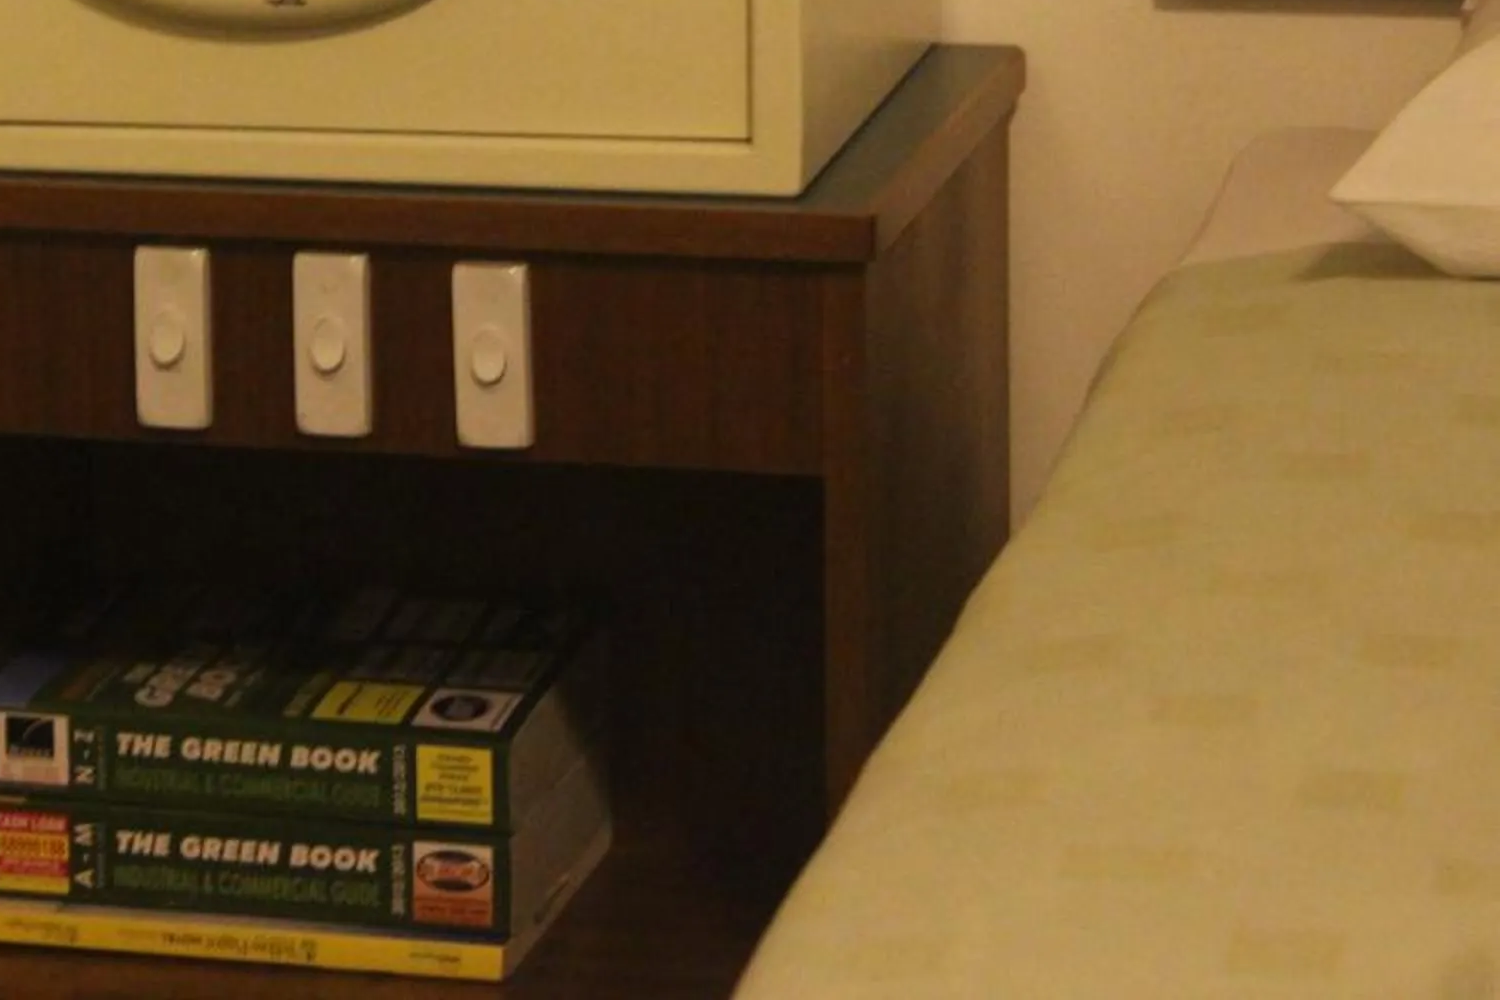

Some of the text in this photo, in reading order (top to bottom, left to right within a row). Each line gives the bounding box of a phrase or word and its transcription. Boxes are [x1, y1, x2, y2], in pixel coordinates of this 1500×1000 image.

[116, 733, 381, 774] THE GREEN BOOK
[116, 830, 381, 873] THE GREEN BOOK
